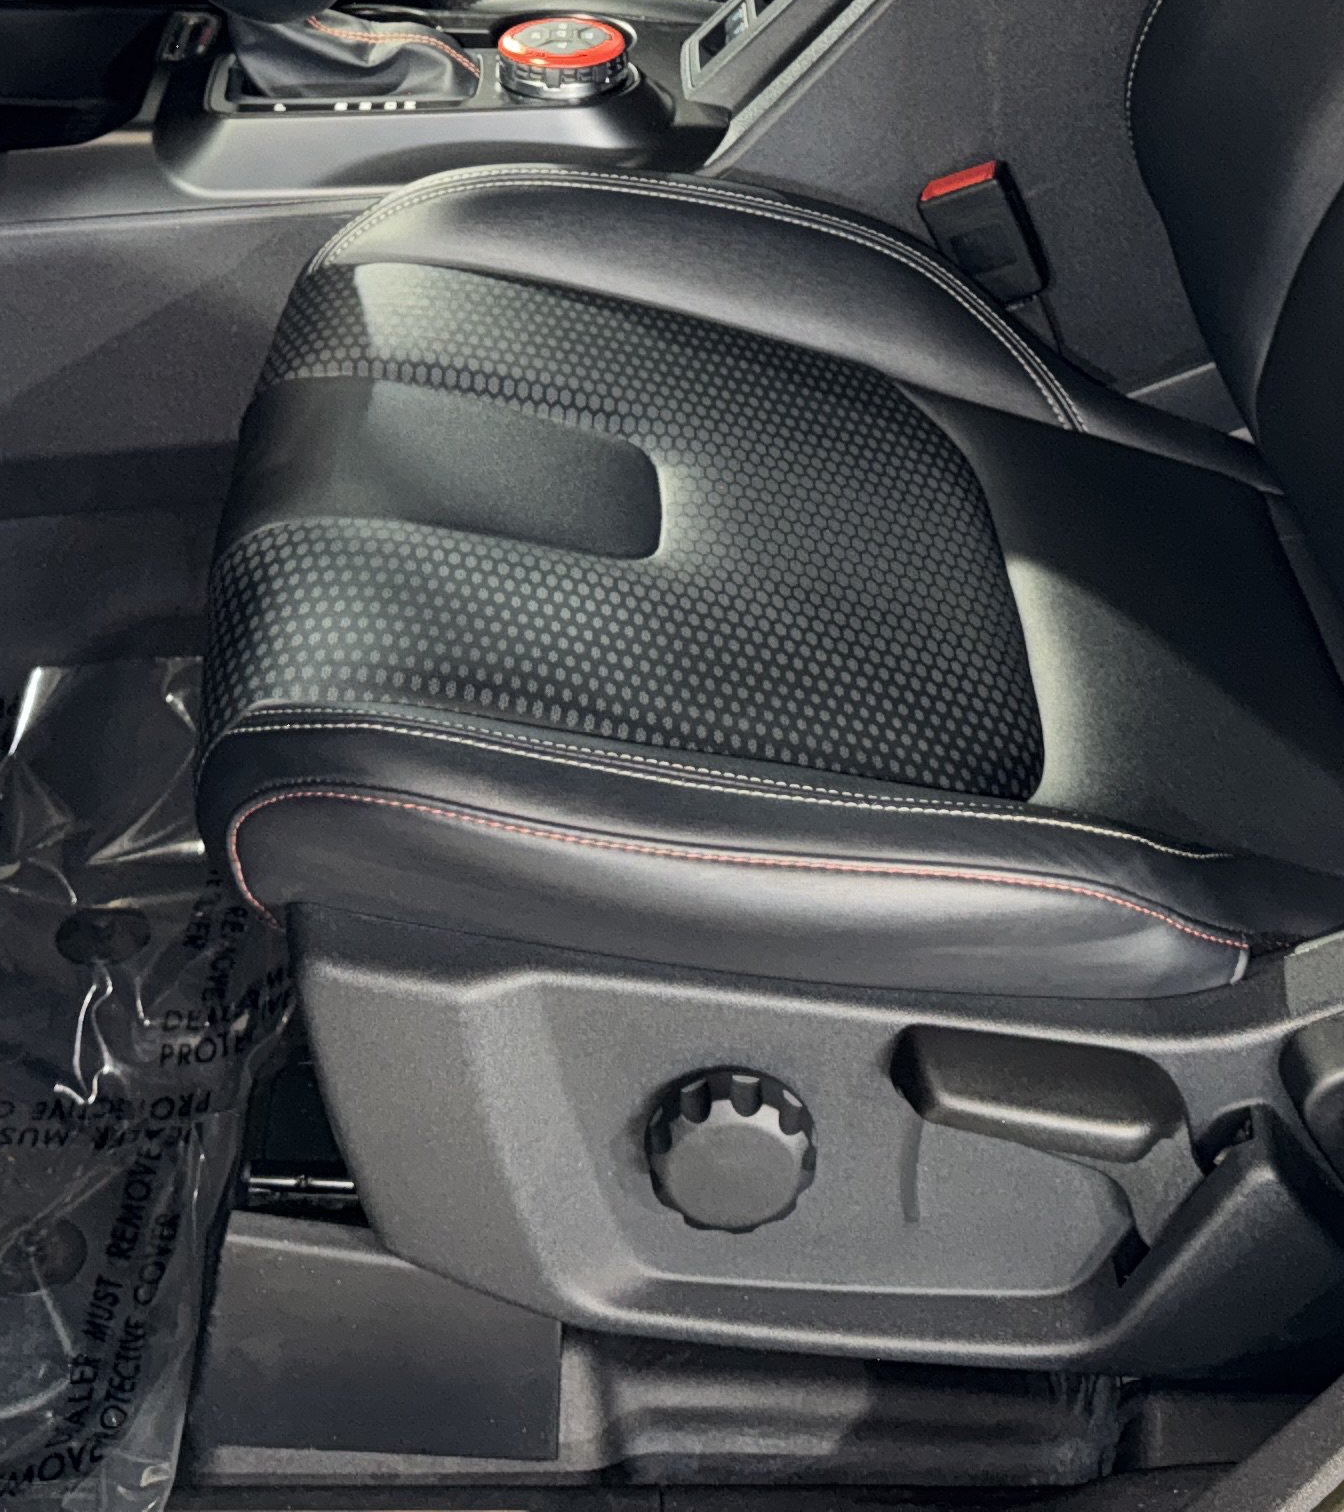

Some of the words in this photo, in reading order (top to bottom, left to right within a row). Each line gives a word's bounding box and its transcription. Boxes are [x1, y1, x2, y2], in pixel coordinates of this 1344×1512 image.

[82, 1273, 124, 1343] MUST
[106, 1142, 162, 1262] REMOVE
[133, 1211, 181, 1308] COVER
